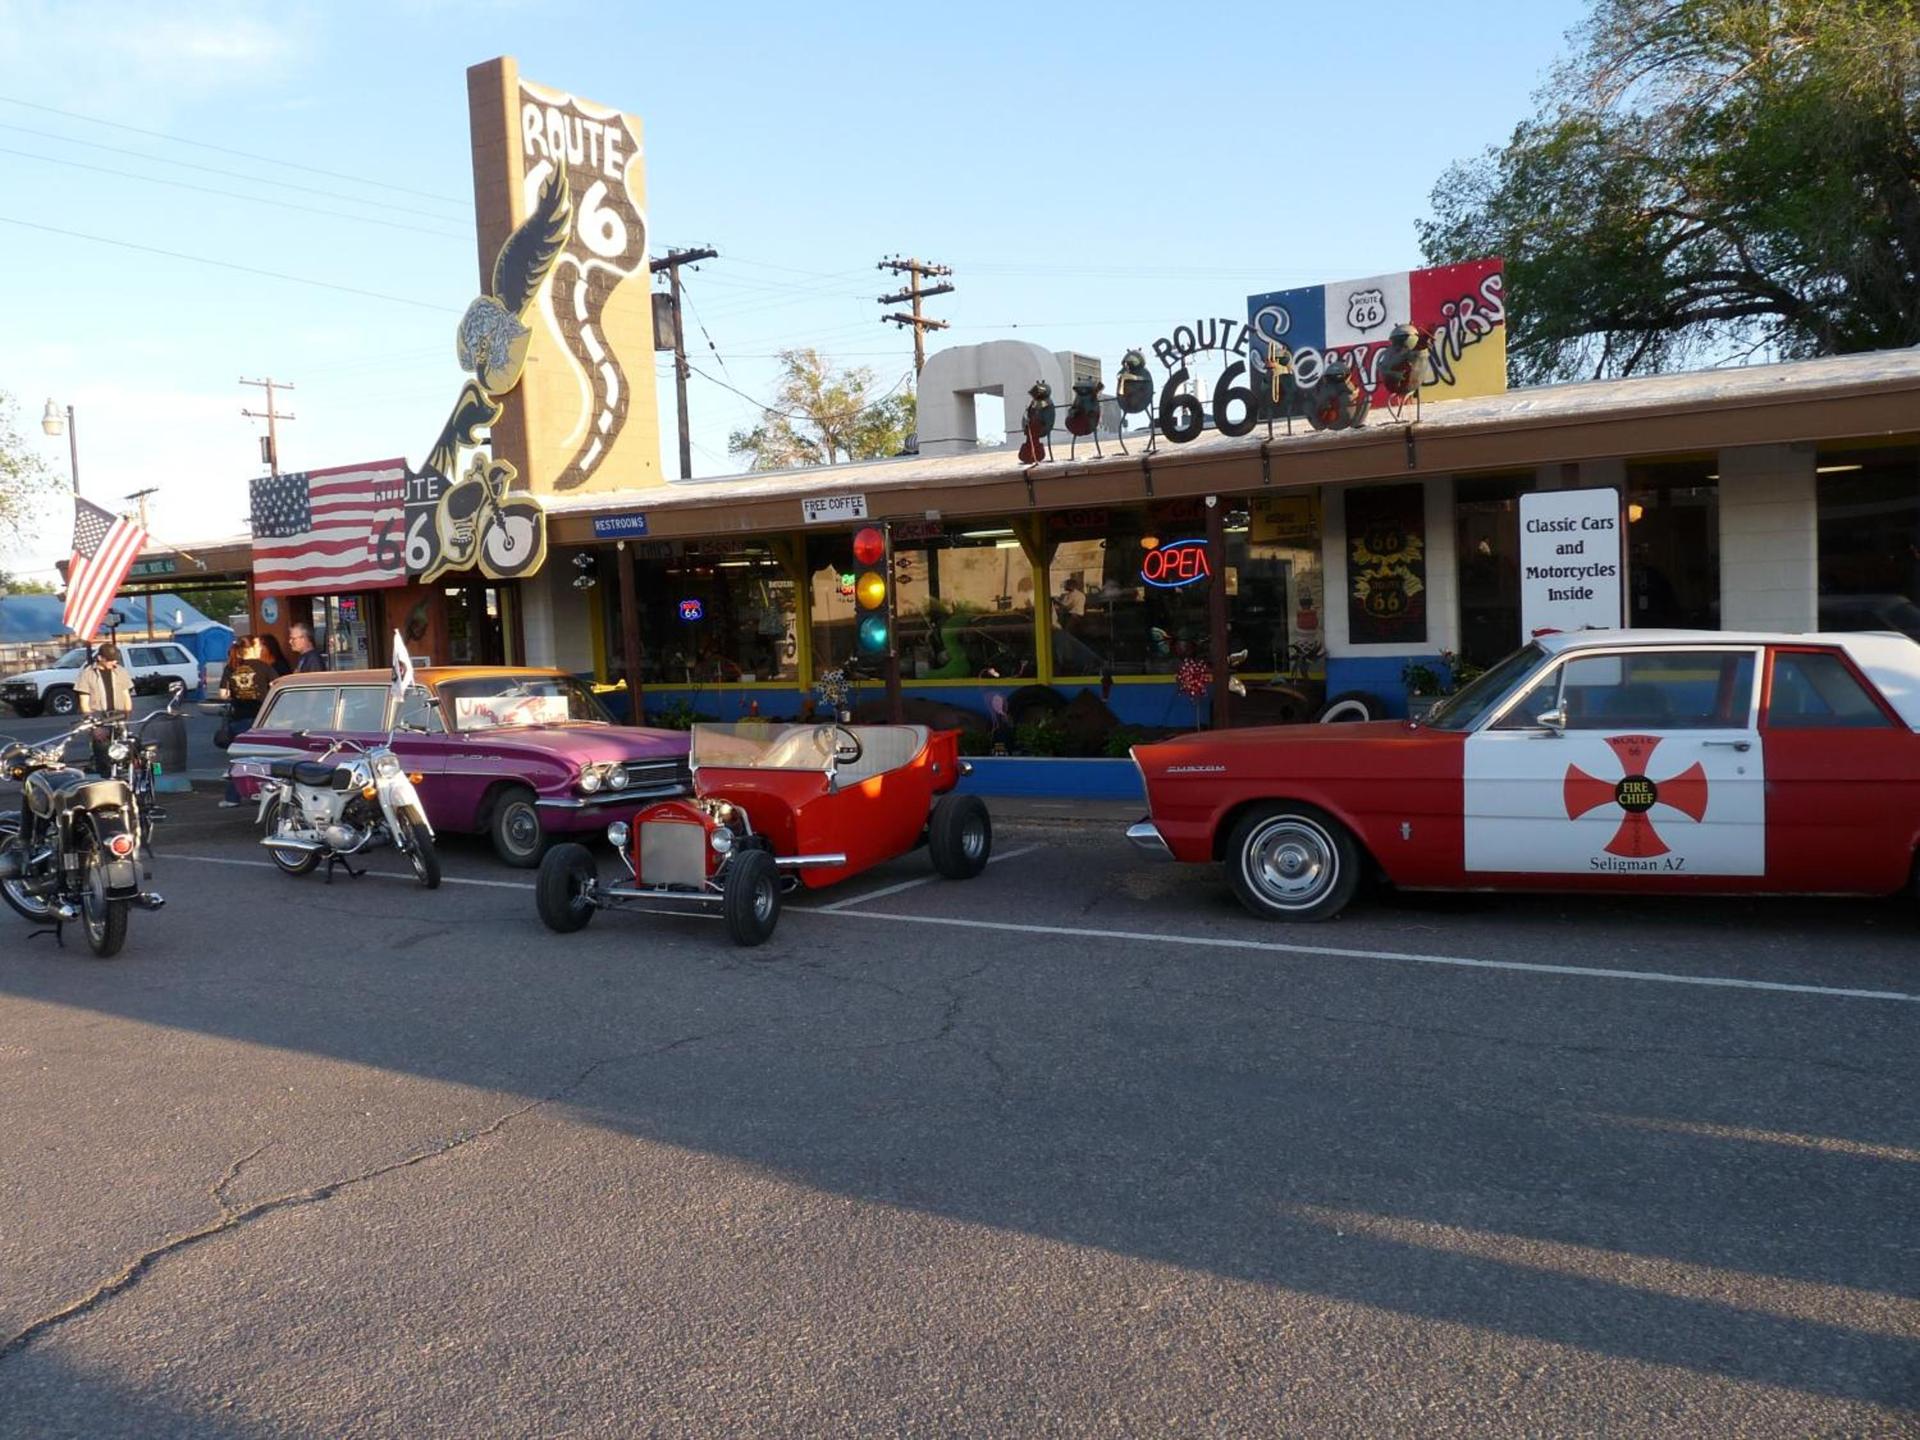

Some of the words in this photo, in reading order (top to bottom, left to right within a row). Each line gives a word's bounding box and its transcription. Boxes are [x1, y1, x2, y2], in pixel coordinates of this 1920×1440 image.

[522, 103, 624, 180] ROUTE
[1355, 296, 1380, 305] ROUTE
[1356, 305, 1378, 322] 66
[1152, 318, 1257, 369] ROUTE
[1160, 360, 1259, 444] 66
[804, 500, 827, 512] FREE
[829, 496, 863, 509] COFFEE
[595, 516, 644, 531] RESTROOMS
[1526, 517, 1577, 533] Classic
[1581, 517, 1614, 530] Cars
[376, 512, 431, 571] 66
[1373, 535, 1399, 550] 66
[1556, 540, 1584, 555] and
[1143, 548, 1211, 580] OPEN
[1526, 563, 1616, 580] Motorcycles
[1548, 586, 1594, 601] Inside
[1374, 596, 1400, 611] 66
[685, 608, 698, 618] 66
[1623, 782, 1649, 793] FIRE
[1618, 793, 1654, 804] CHIEF
[1590, 857, 1657, 874] Seligman
[1663, 857, 1686, 871] AZ
